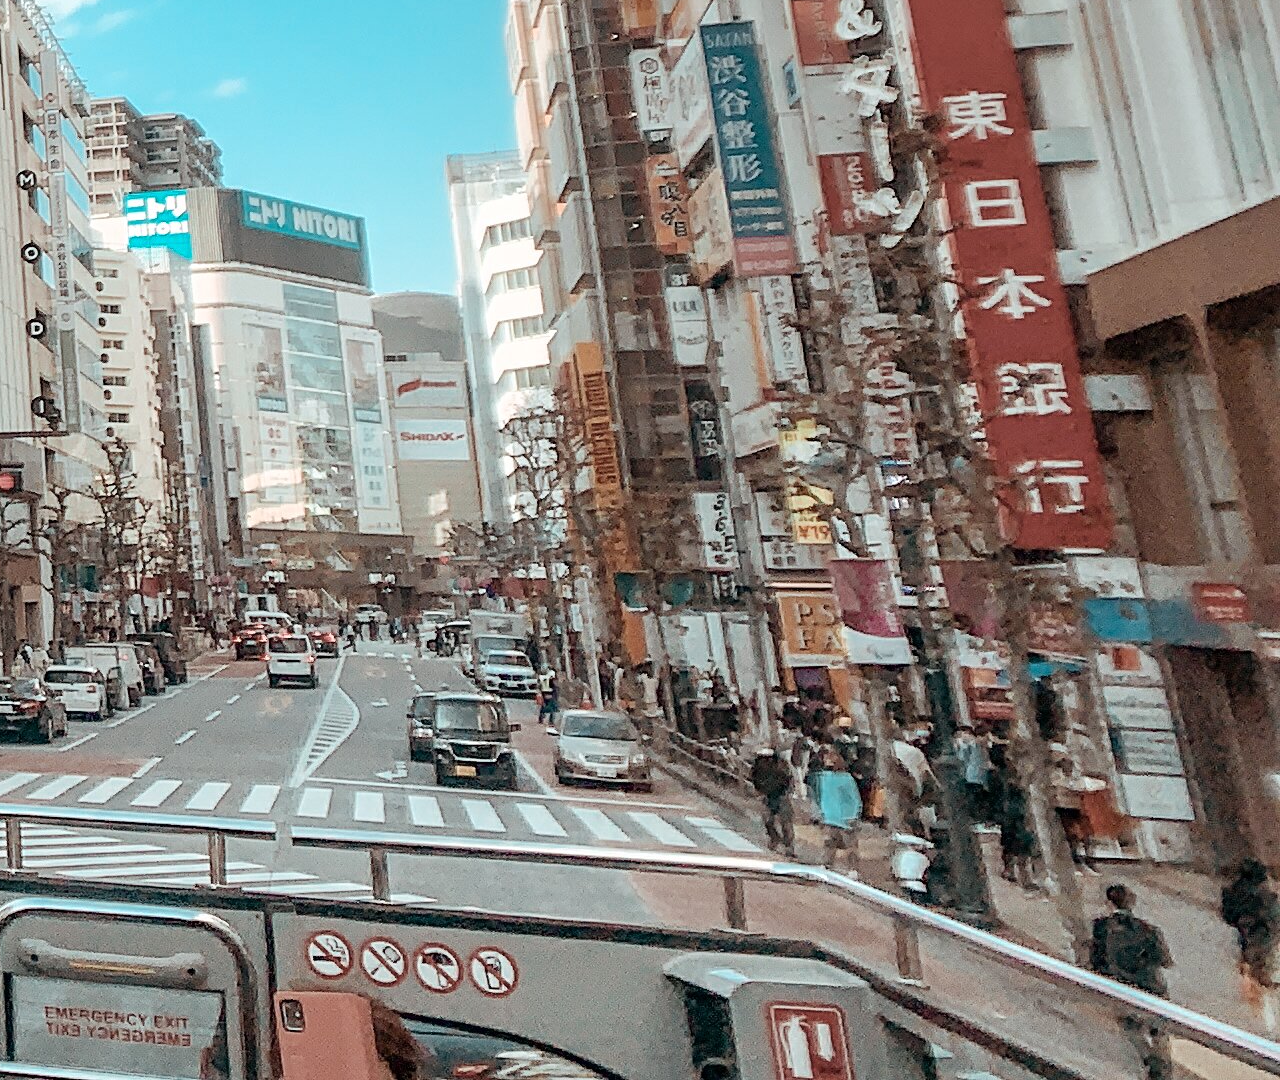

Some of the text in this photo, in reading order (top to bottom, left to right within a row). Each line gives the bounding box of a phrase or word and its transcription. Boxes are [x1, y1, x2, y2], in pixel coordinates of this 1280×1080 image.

[710, 54, 763, 183] 渋谷整形
[127, 195, 187, 220] ニトリ
[248, 196, 358, 243] ニトリ NITORI
[128, 220, 188, 237] NITORI
[942, 91, 1089, 514] 東日本銀行
[44, 1006, 189, 1029] EMERGENCY EXIT
